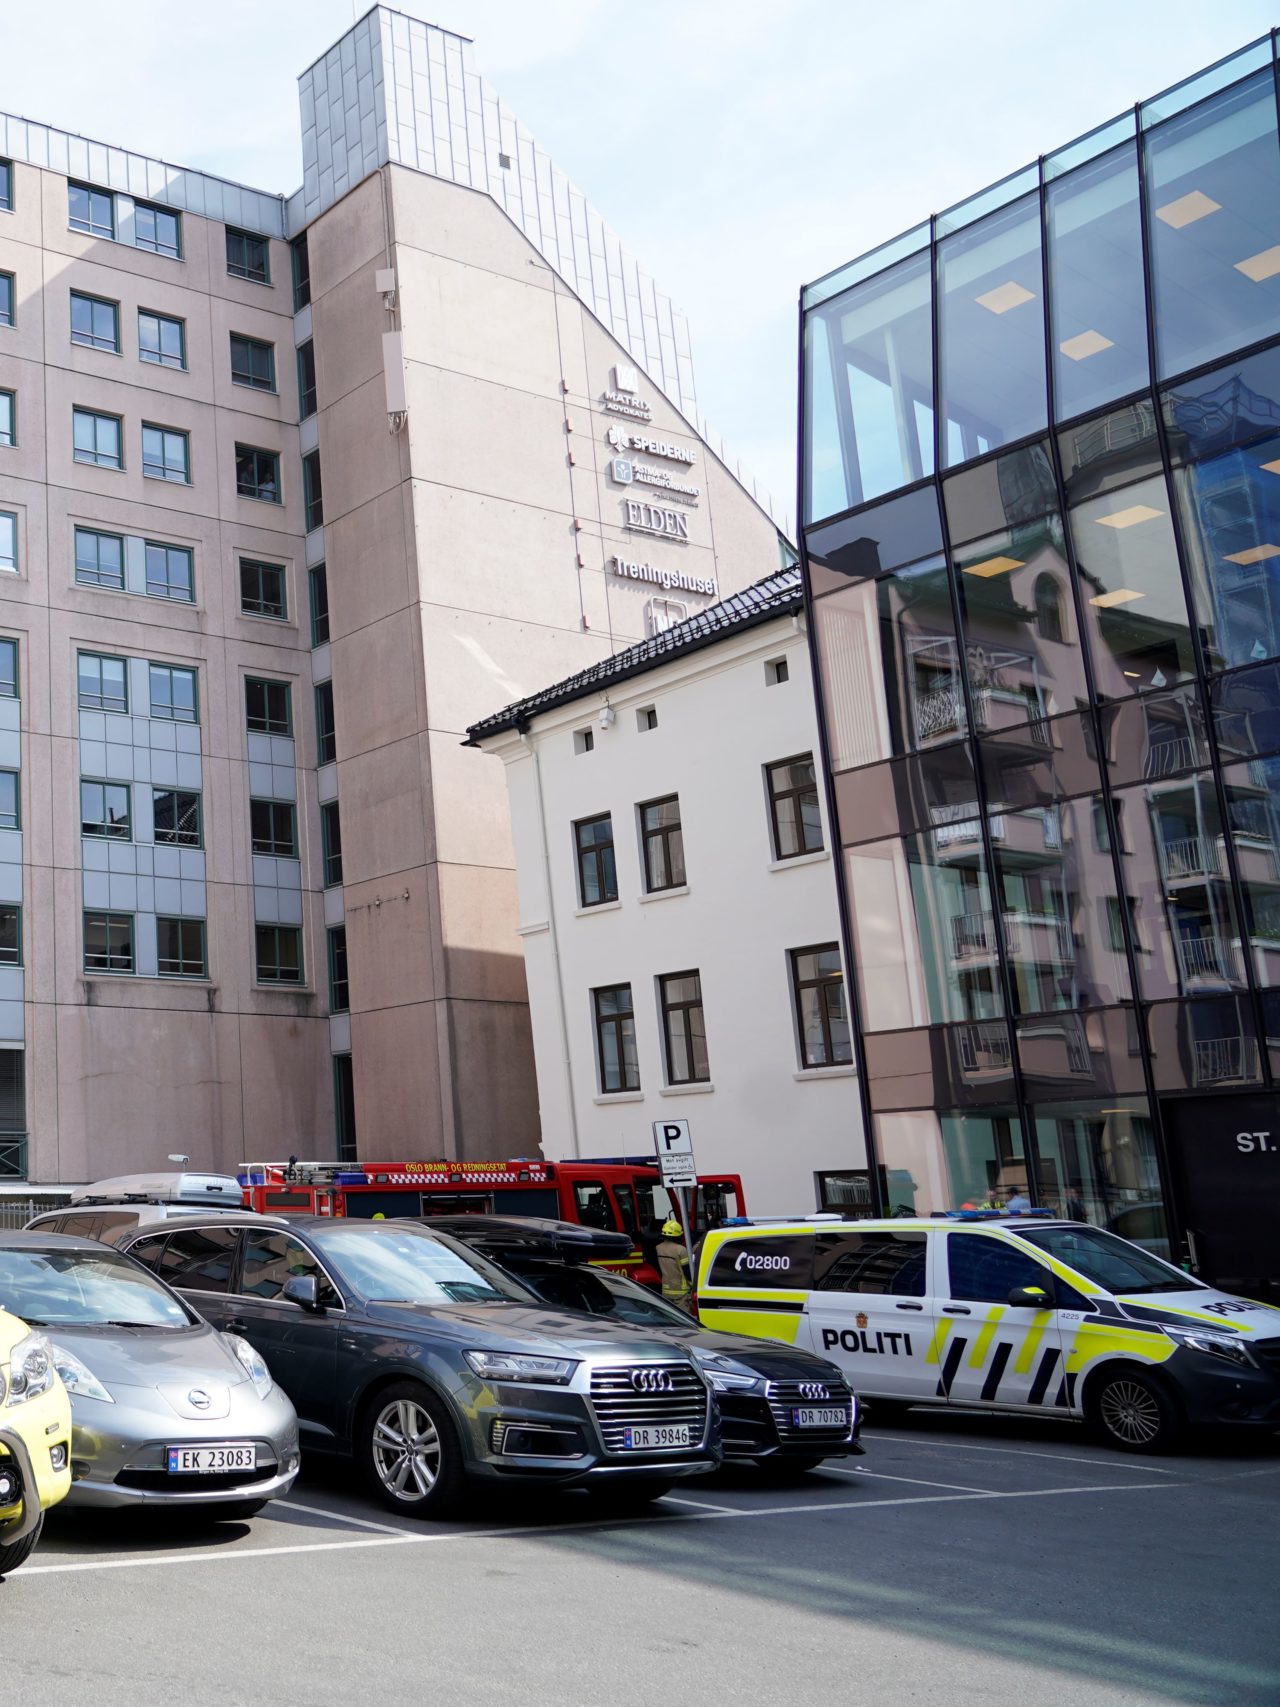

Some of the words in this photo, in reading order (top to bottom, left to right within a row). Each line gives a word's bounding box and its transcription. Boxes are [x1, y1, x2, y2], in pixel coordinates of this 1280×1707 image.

[605, 391, 652, 410] MATRIX
[633, 435, 697, 464] SPEIDERNE
[626, 500, 690, 539] ELDEN
[613, 555, 719, 596] Treningshuset
[663, 1125, 682, 1150] P
[1236, 1131, 1277, 1152] ST.
[405, 1163, 424, 1173] OSLO
[424, 1163, 449, 1172] BRANN-
[451, 1163, 462, 1172] OG
[463, 1163, 507, 1172] REDNINGSETAT
[746, 1255, 790, 1270] 02800
[1060, 1312, 1080, 1320] 4225
[821, 1328, 913, 1356] POLITI
[801, 1409, 815, 1423] DR
[817, 1408, 845, 1423] 70782
[633, 1429, 650, 1445] DR
[654, 1427, 689, 1444] 39846
[183, 1451, 200, 1468] EK
[207, 1449, 252, 1468] 23083
